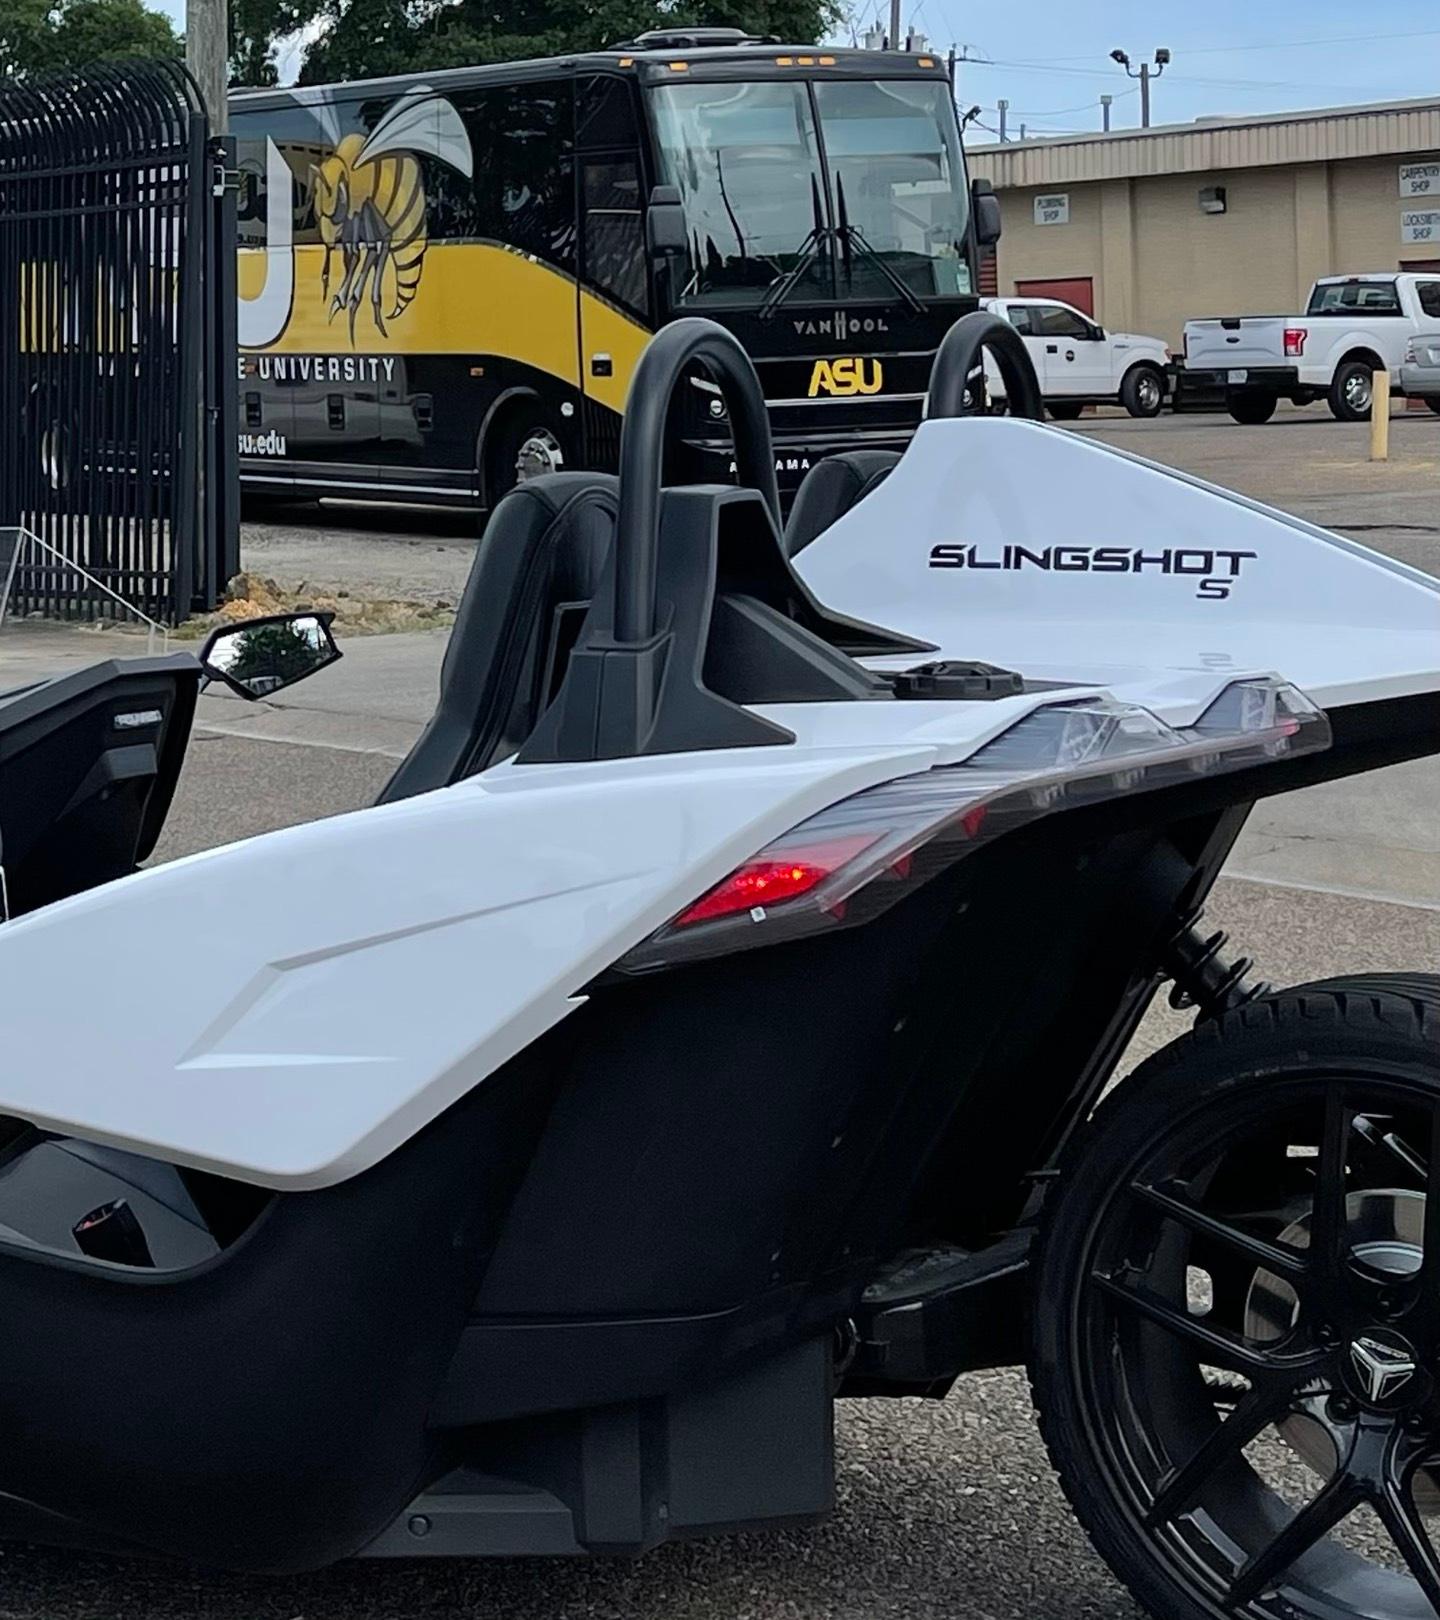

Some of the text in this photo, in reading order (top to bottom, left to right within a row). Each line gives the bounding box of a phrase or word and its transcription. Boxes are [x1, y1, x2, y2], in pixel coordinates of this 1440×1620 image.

[1411, 180, 1430, 193] SHOP
[1413, 227, 1432, 240] SHOP
[259, 357, 395, 382] UNIVERSITY
[808, 358, 883, 397] ASU
[929, 544, 1258, 576] SLINGSHOT
[1196, 578, 1233, 599] S
